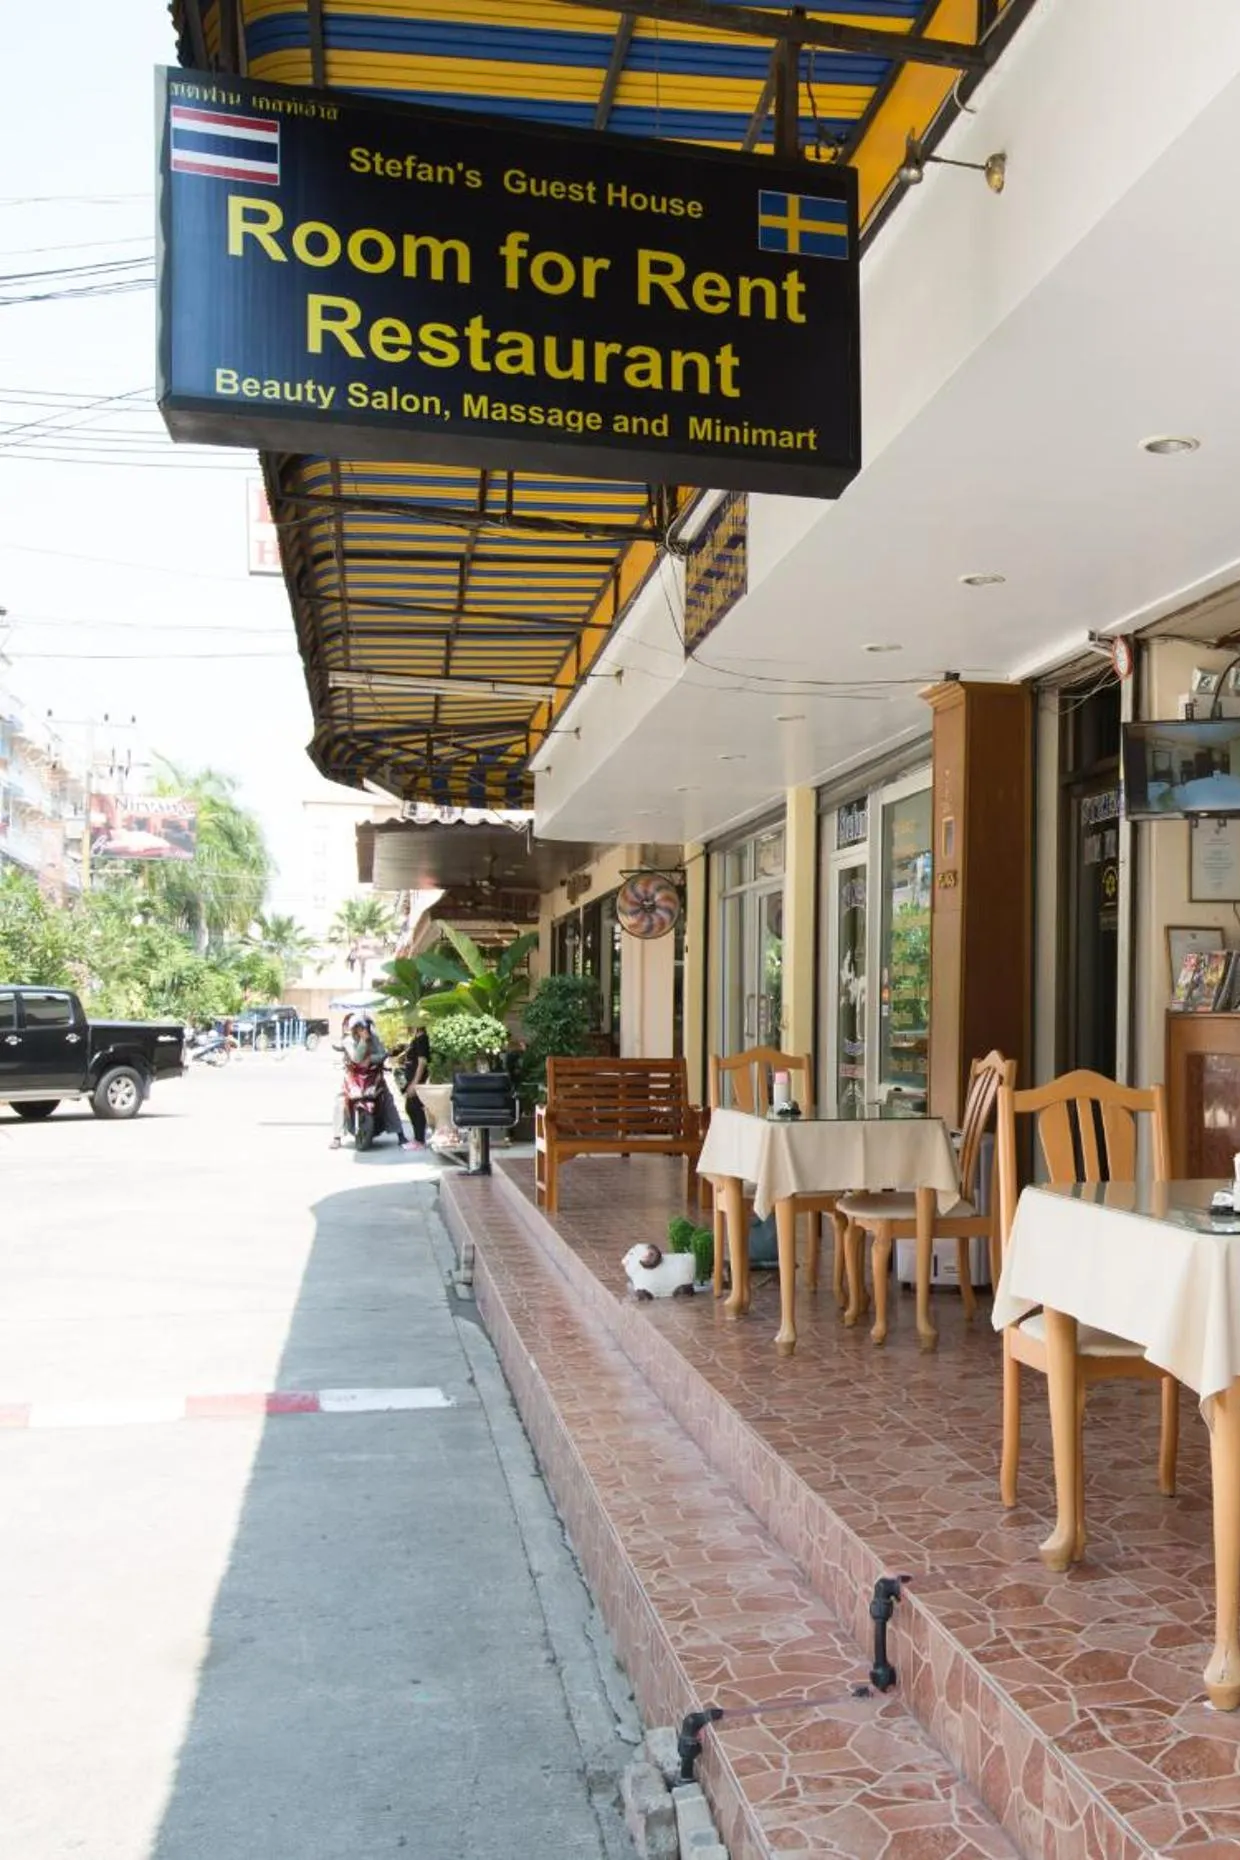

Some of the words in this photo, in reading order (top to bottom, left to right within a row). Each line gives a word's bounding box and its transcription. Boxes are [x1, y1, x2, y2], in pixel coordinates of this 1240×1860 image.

[350, 147, 484, 188] Stefan's
[503, 169, 597, 204] Guest
[607, 183, 704, 219] House
[226, 194, 472, 284] Room
[499, 231, 610, 299] for
[637, 248, 807, 325] Rent
[306, 293, 741, 398] Restaurant
[215, 367, 335, 410] Beauty
[346, 382, 451, 421] Salon,
[462, 393, 603, 434] Massage
[612, 414, 669, 438] and
[688, 416, 818, 452] Minimart
